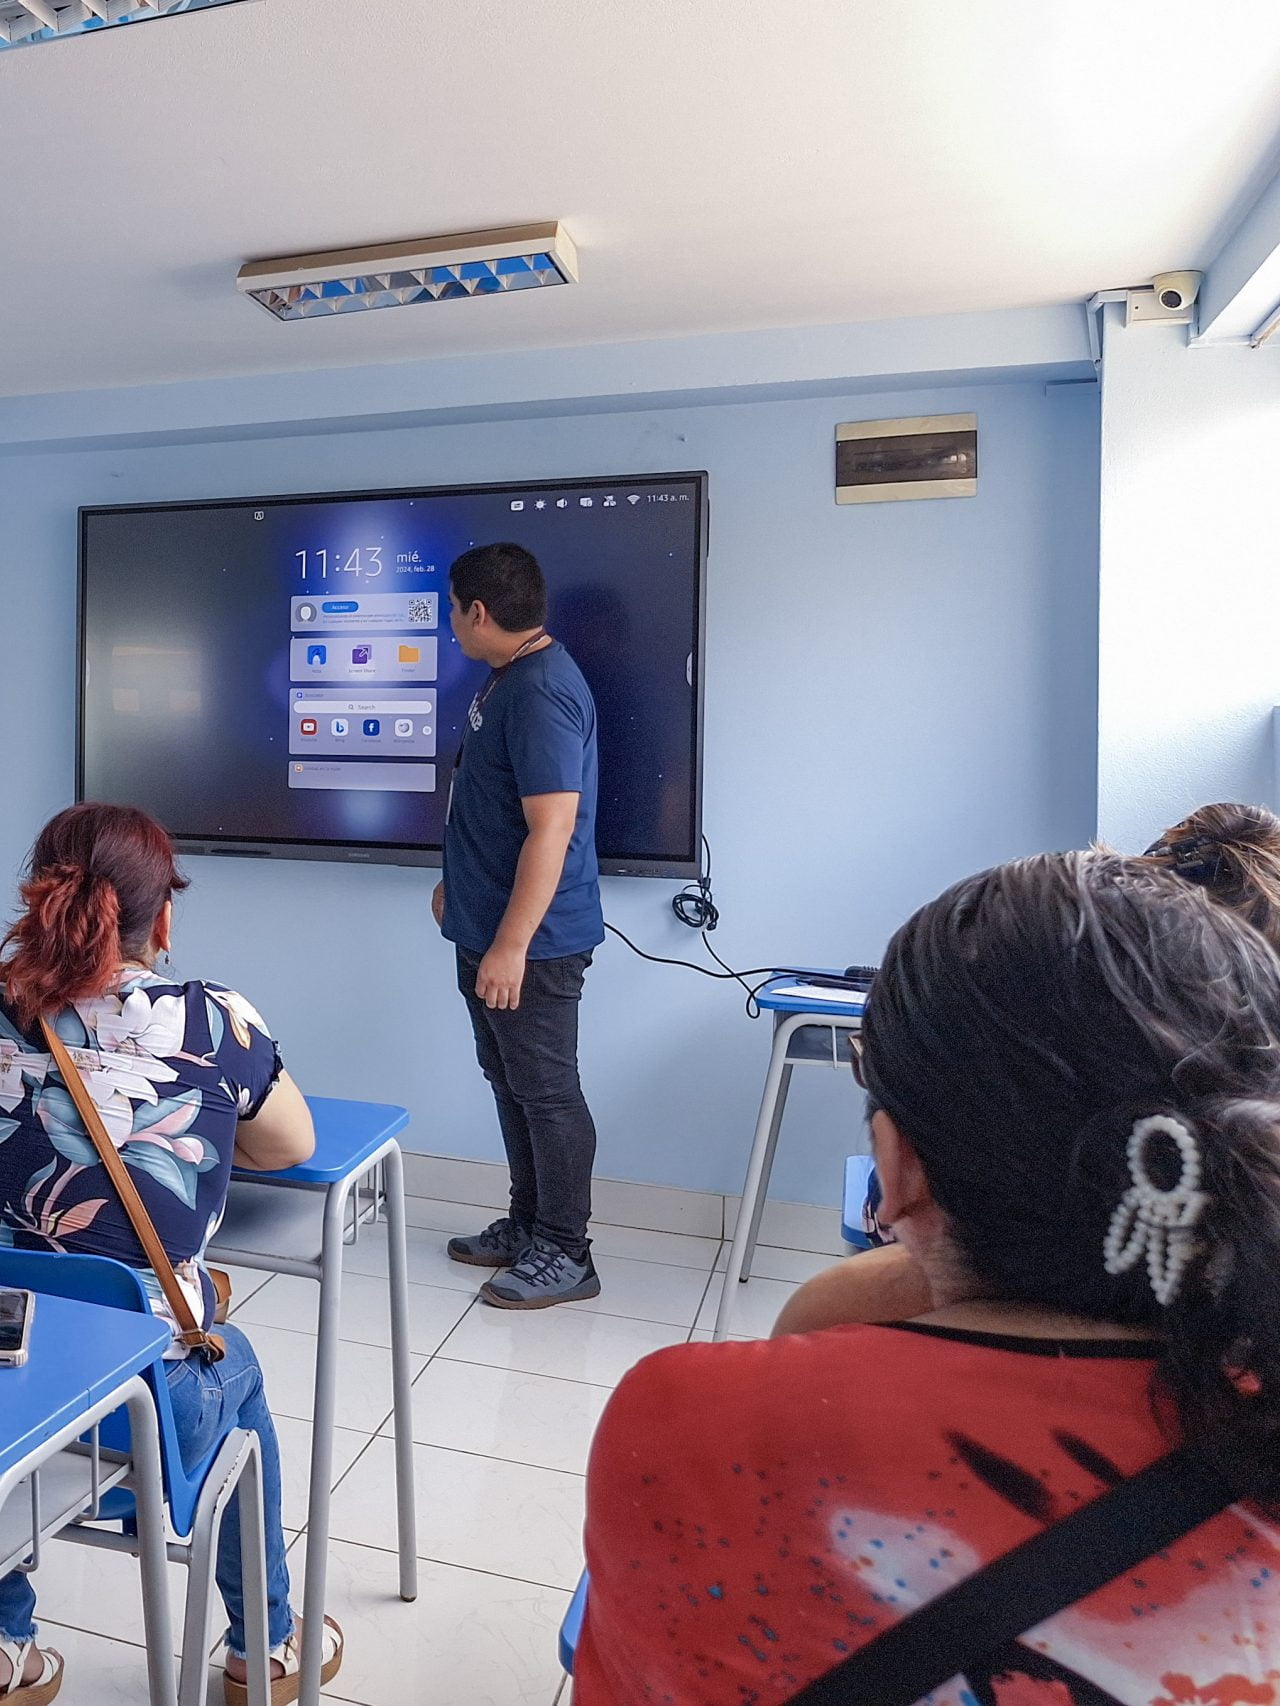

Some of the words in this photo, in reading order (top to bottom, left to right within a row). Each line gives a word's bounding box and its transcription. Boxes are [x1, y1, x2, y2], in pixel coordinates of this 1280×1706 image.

[646, 494, 669, 502] 11:43
[396, 550, 422, 563] mié.
[295, 547, 383, 579] 11:43
[414, 565, 425, 573] feb.
